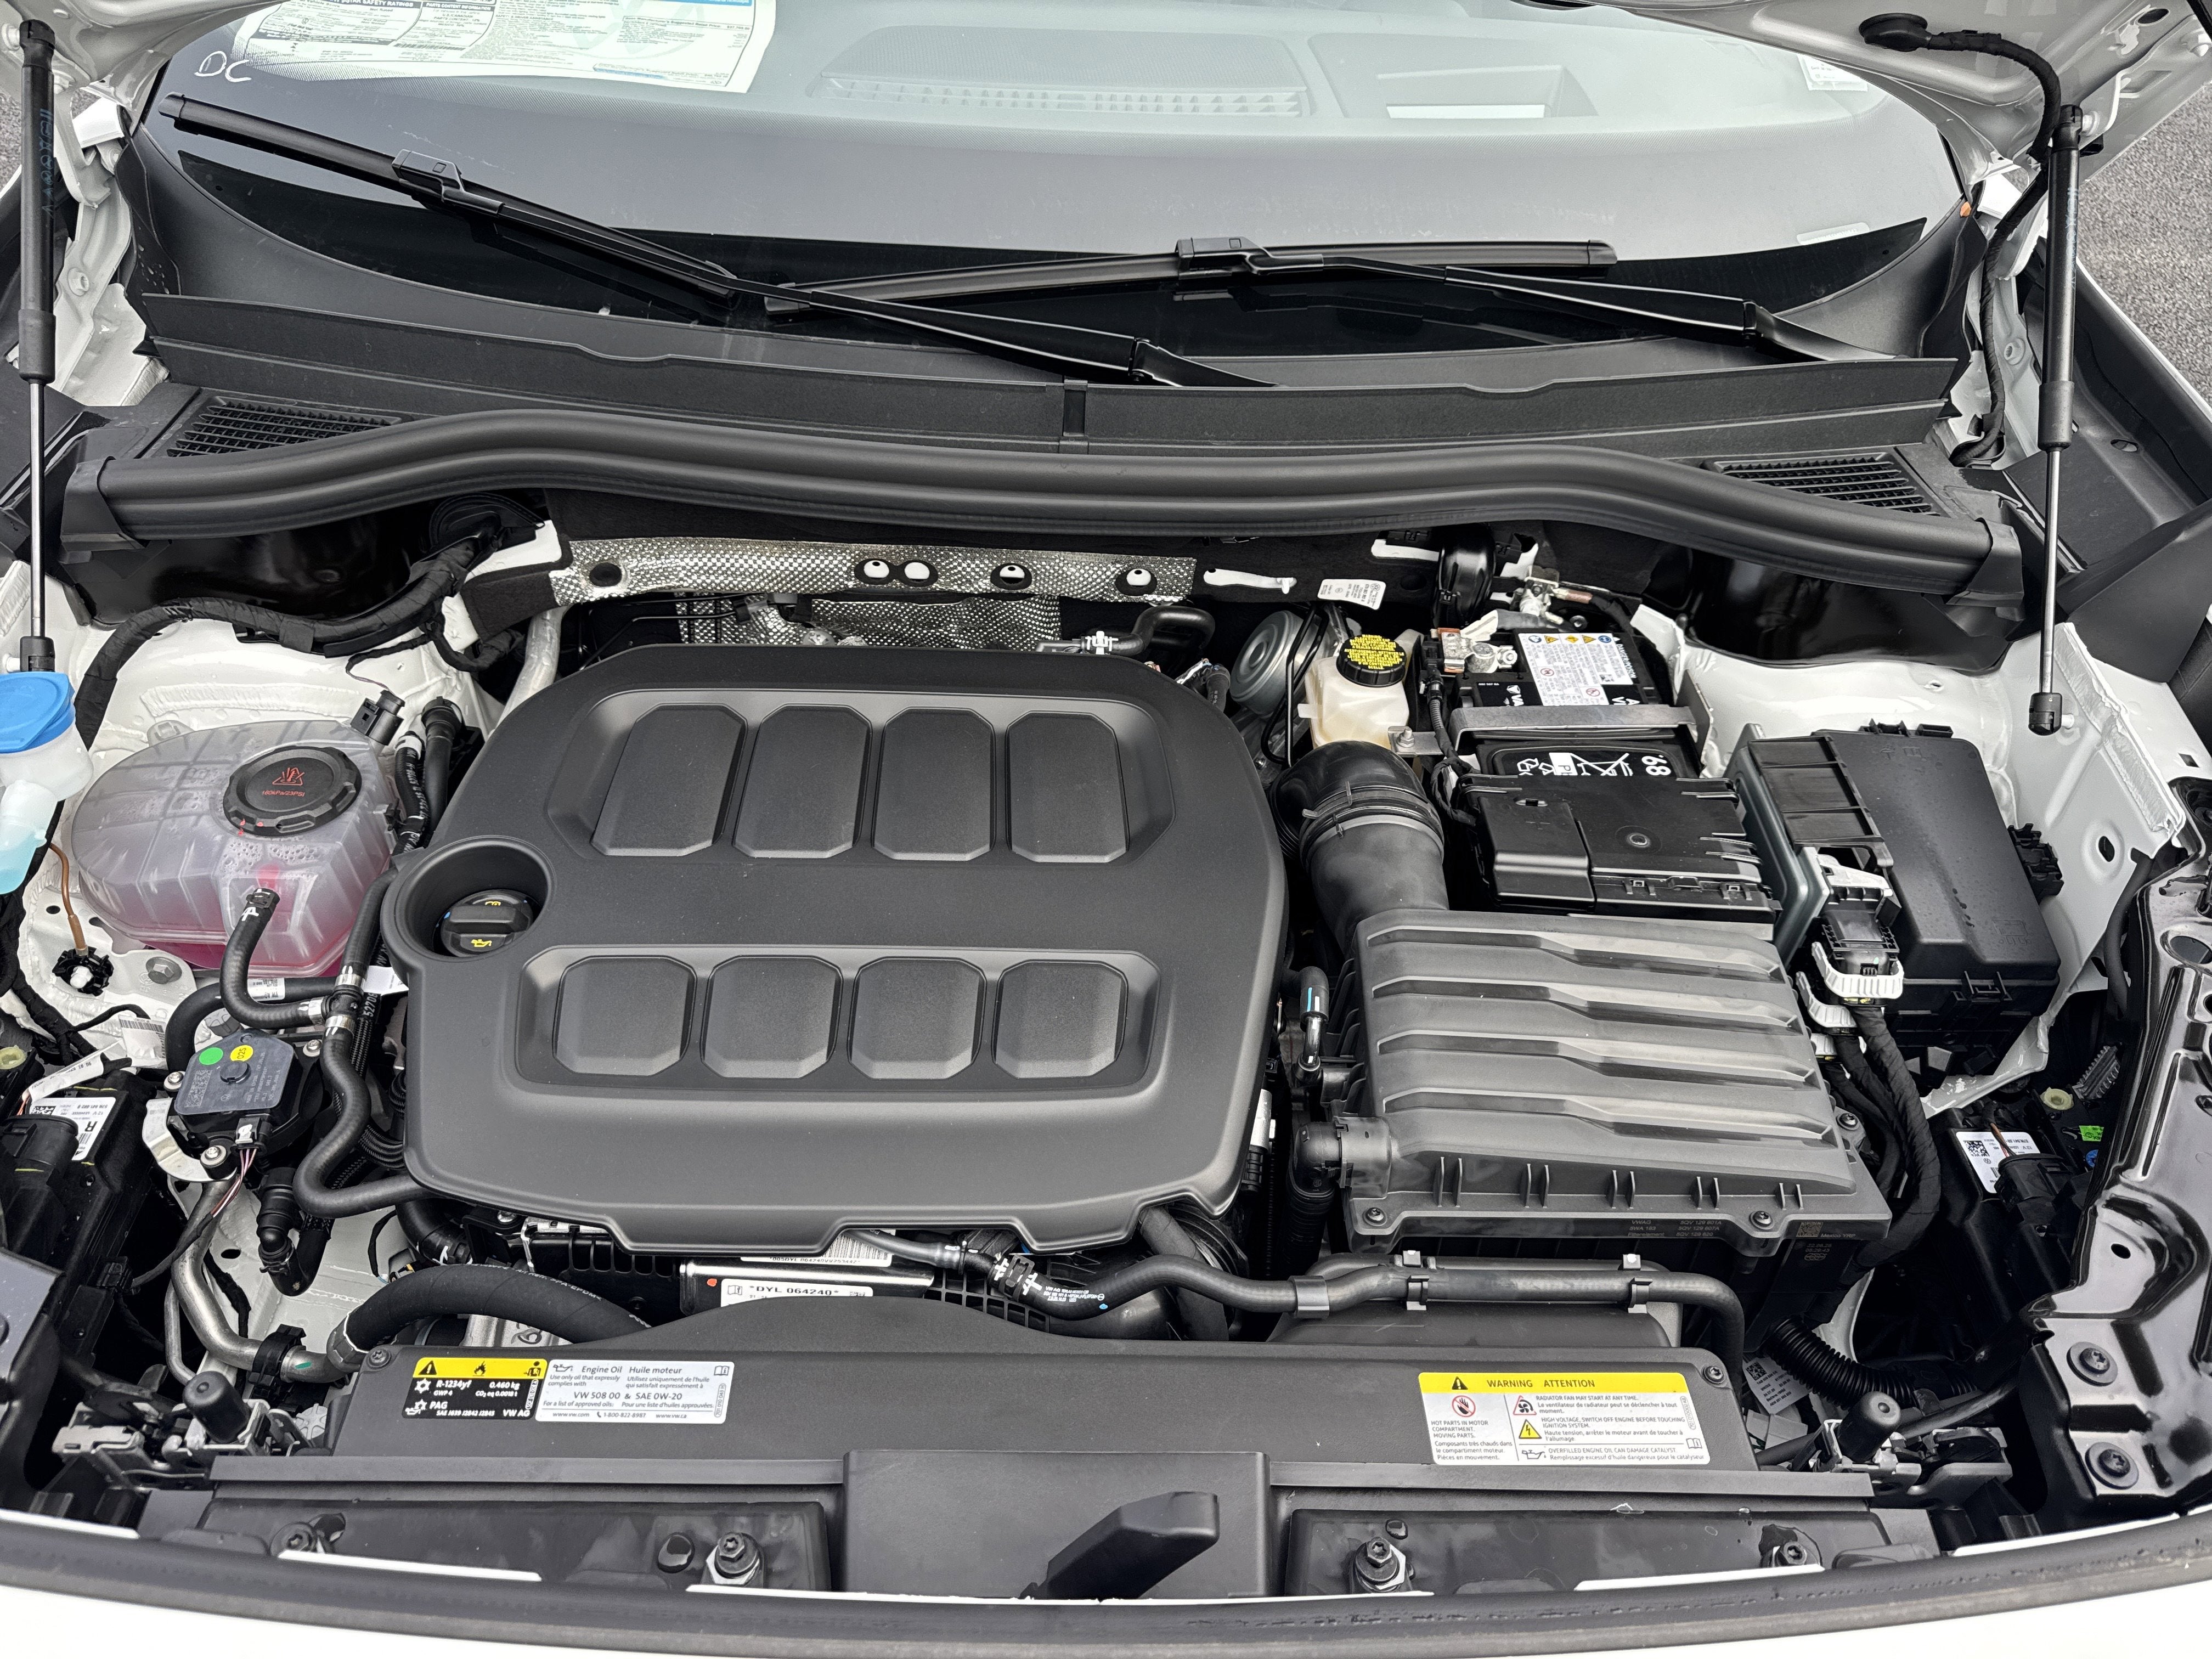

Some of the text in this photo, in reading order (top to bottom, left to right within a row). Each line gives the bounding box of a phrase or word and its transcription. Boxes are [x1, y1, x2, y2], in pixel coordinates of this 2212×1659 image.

[84, 1121, 98, 1132] R
[582, 1366, 609, 1374] Engine
[436, 1380, 472, 1390] R-1234yf
[429, 1401, 448, 1409] PAG
